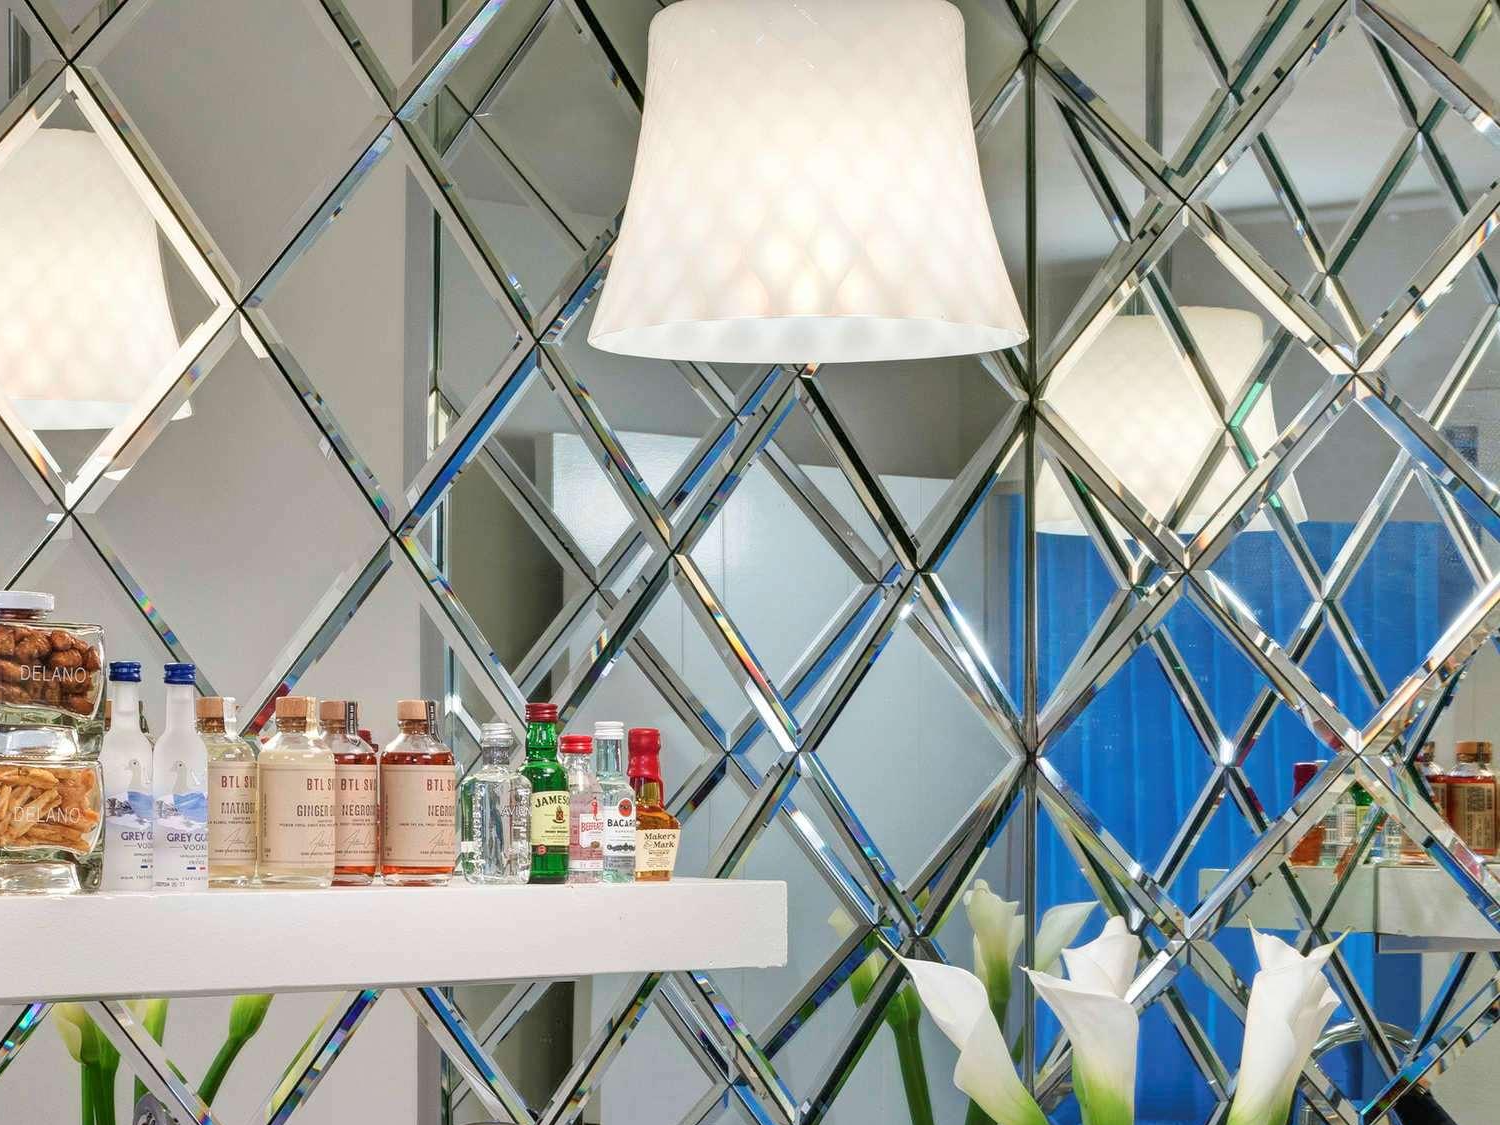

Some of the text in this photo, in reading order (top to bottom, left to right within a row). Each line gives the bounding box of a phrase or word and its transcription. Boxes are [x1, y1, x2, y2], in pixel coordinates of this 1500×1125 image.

[20, 664, 87, 684] DELANO
[222, 775, 240, 789] BTL
[307, 778, 324, 791] BTL
[340, 778, 360, 791] BTL
[427, 778, 445, 792] BTL
[14, 806, 80, 823] DELANO
[121, 831, 144, 841] GREY
[167, 833, 192, 842] GREY
[653, 841, 675, 849] Mark
